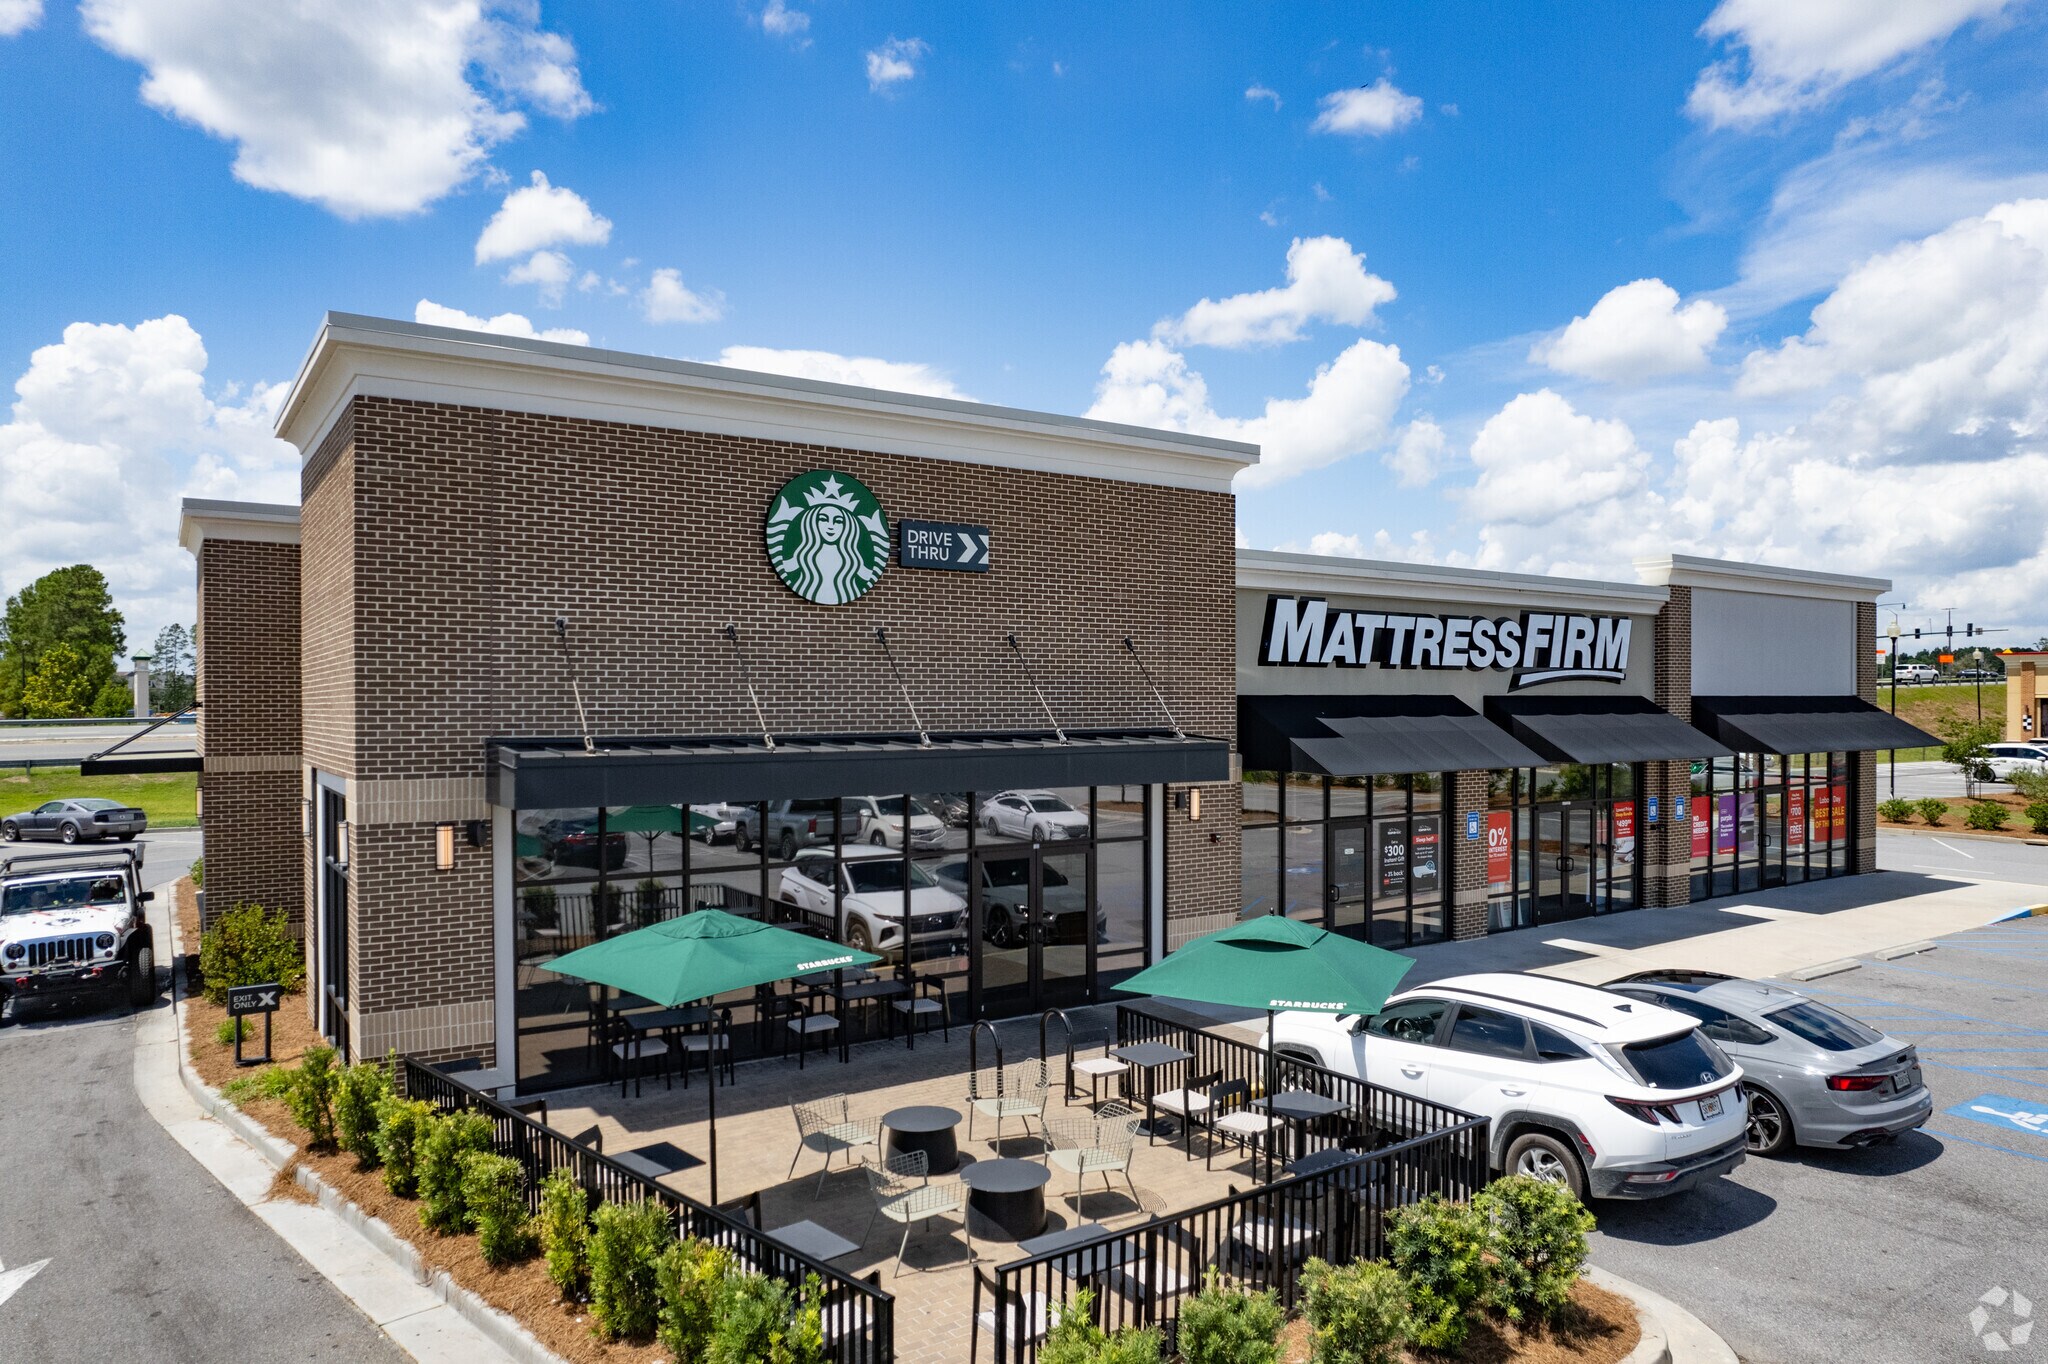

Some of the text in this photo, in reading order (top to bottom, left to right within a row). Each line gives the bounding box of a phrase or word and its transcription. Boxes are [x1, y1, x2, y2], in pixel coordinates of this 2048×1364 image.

[908, 530, 953, 546] DRIVE
[908, 545, 950, 561] THRU
[1815, 806, 1845, 818] BEST SALE
[1832, 818, 1845, 827] YEAR
[1789, 825, 1802, 834] FREE
[1488, 826, 1508, 847] 0%
[1384, 844, 1405, 857] $300
[797, 955, 853, 971] STARBUCKS
[233, 994, 252, 1003] EXIT
[233, 1000, 257, 1010] ONLY
[1269, 1000, 1345, 1010] STARBUCKS
